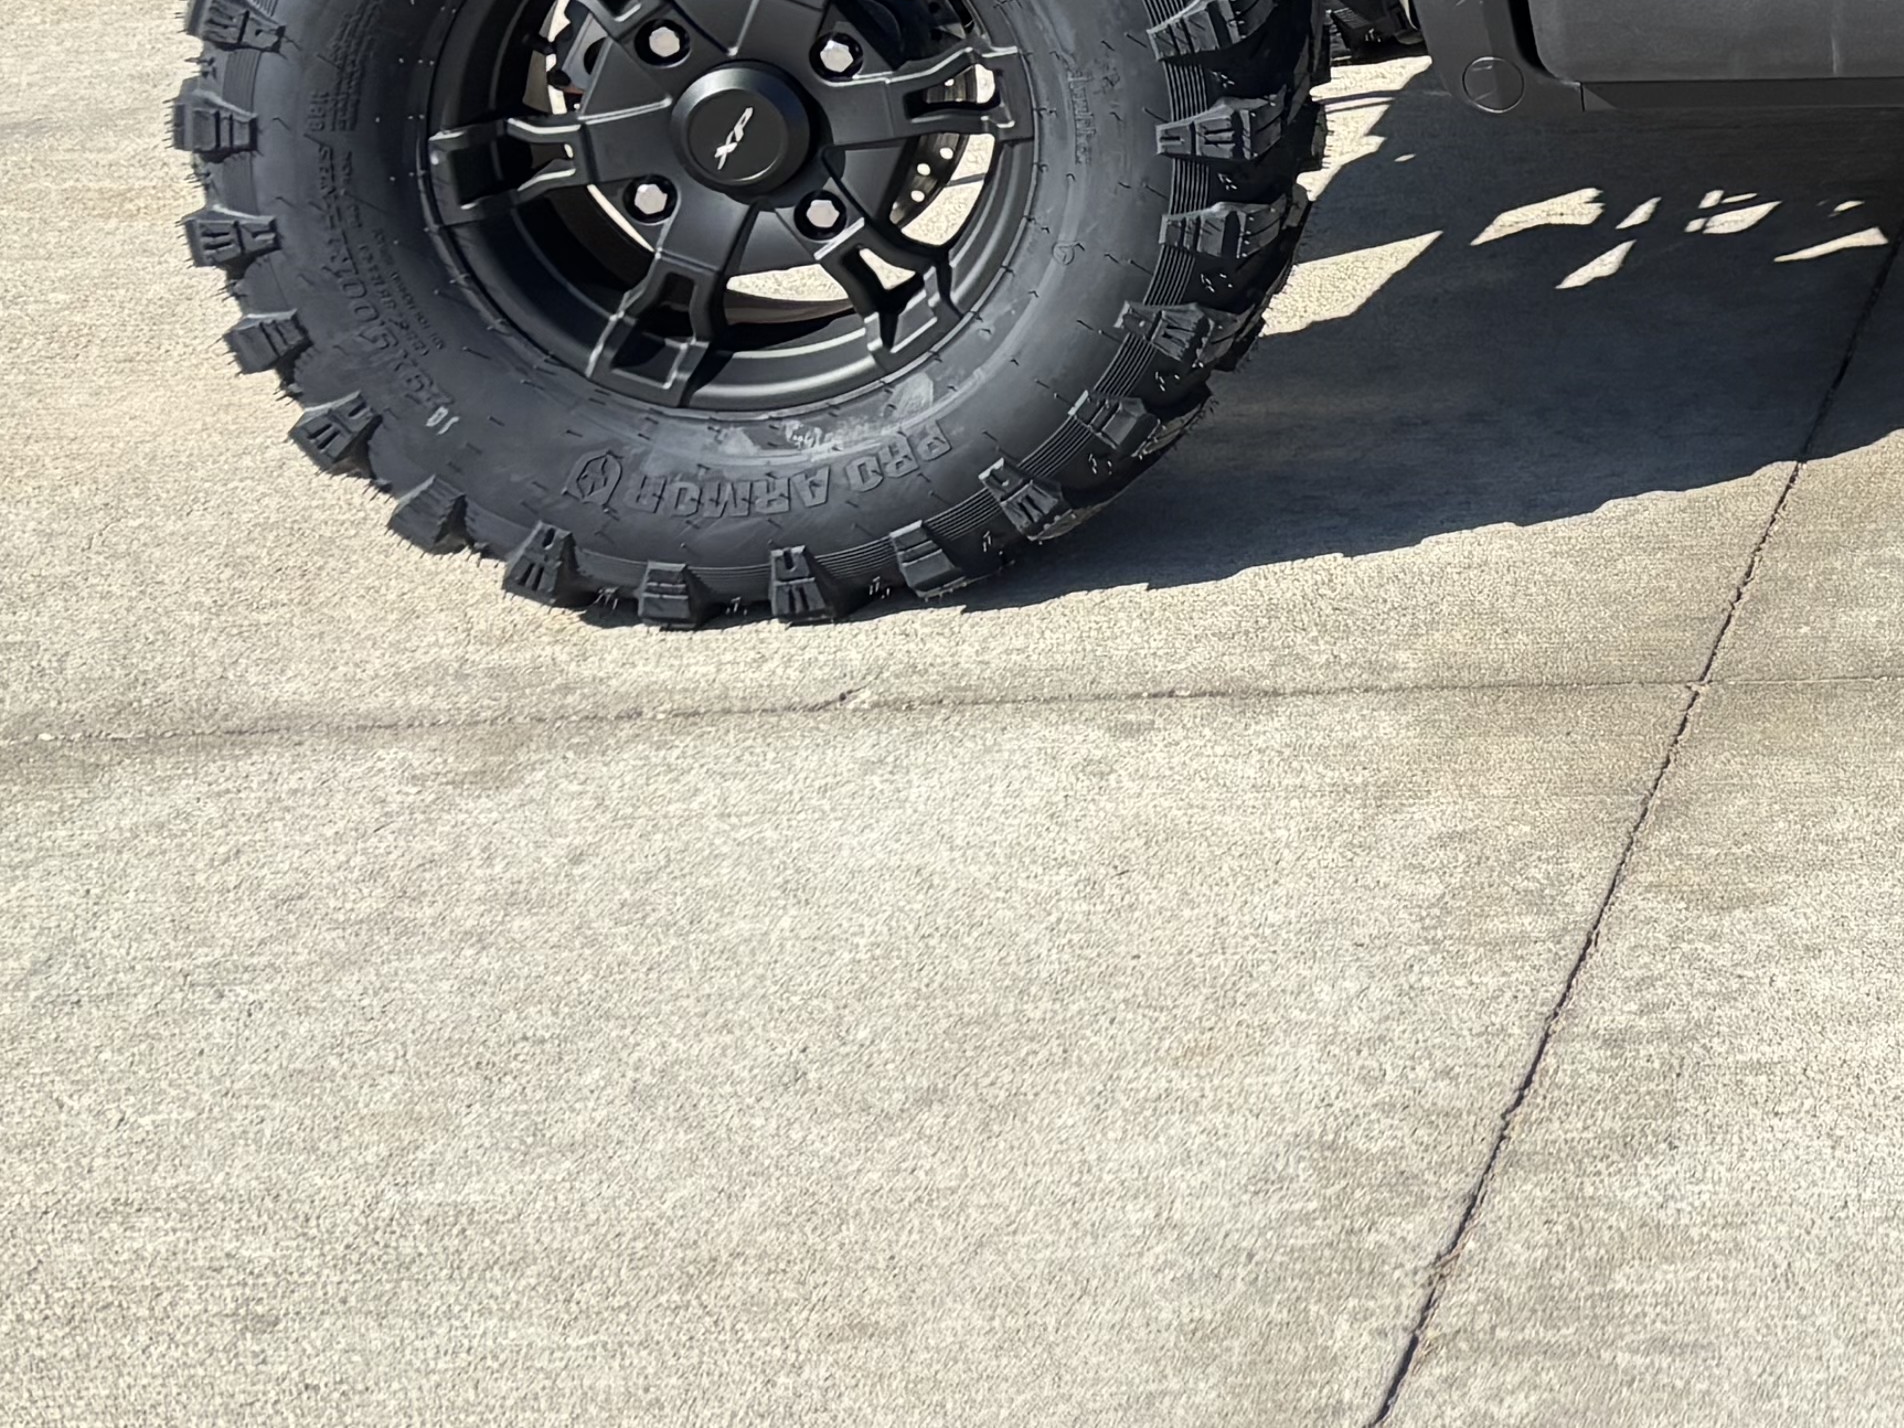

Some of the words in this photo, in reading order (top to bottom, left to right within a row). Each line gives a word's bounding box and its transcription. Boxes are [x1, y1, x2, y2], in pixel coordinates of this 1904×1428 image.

[714, 107, 753, 170] XP
[845, 420, 952, 492] PRO
[624, 464, 831, 518] ARMOR
